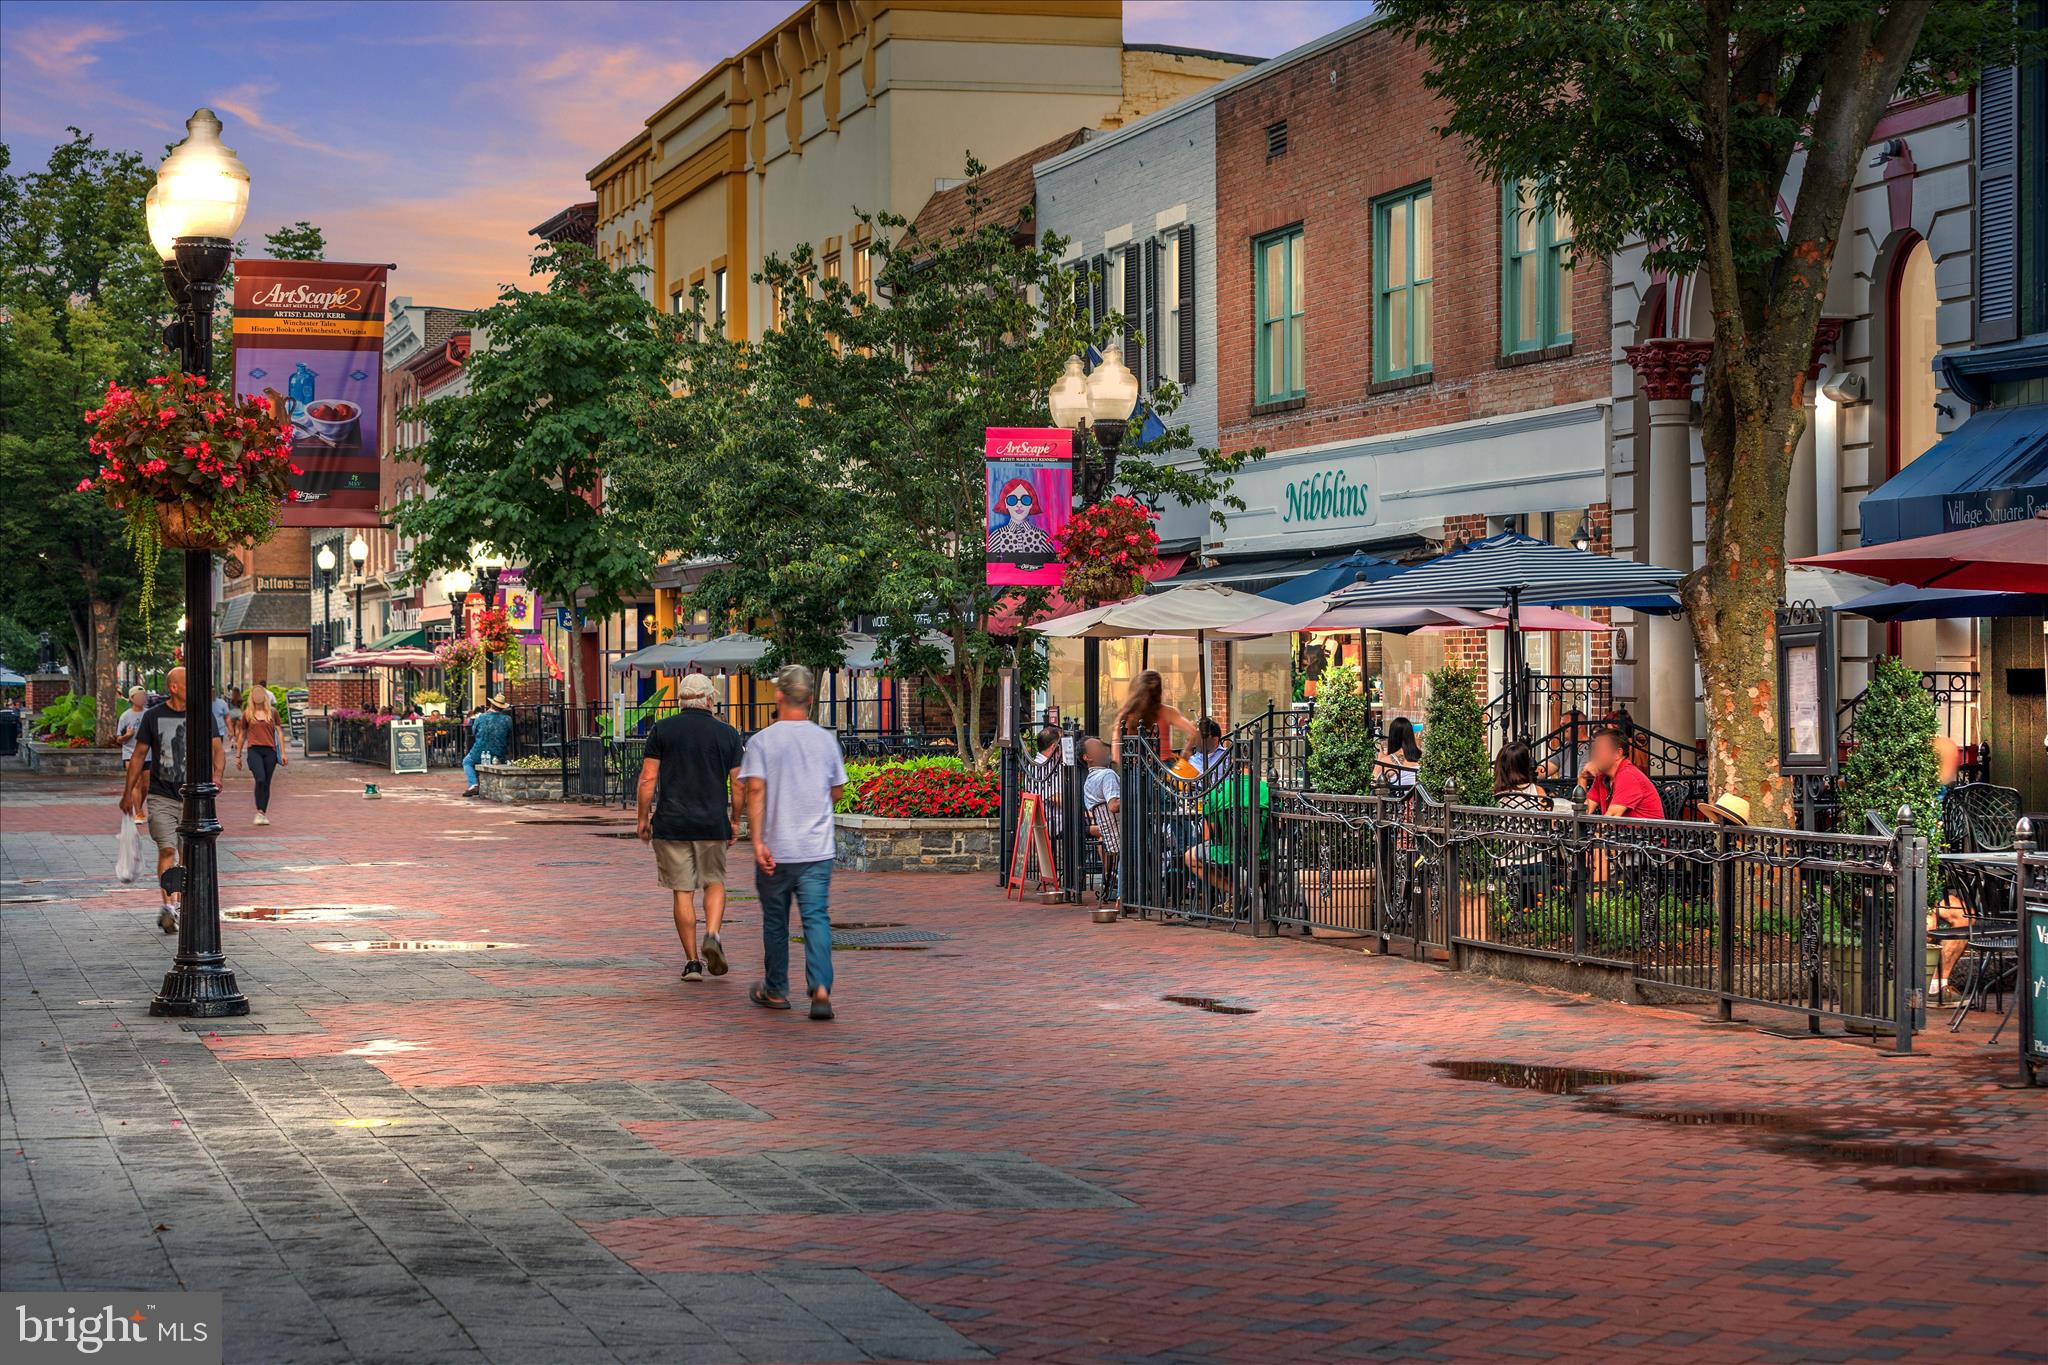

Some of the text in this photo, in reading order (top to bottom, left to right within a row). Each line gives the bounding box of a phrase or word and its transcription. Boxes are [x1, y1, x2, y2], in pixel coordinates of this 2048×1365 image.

[1283, 469, 1368, 523] Nibblins
[1947, 500, 1983, 528] Village
[1985, 498, 2024, 525] Square
